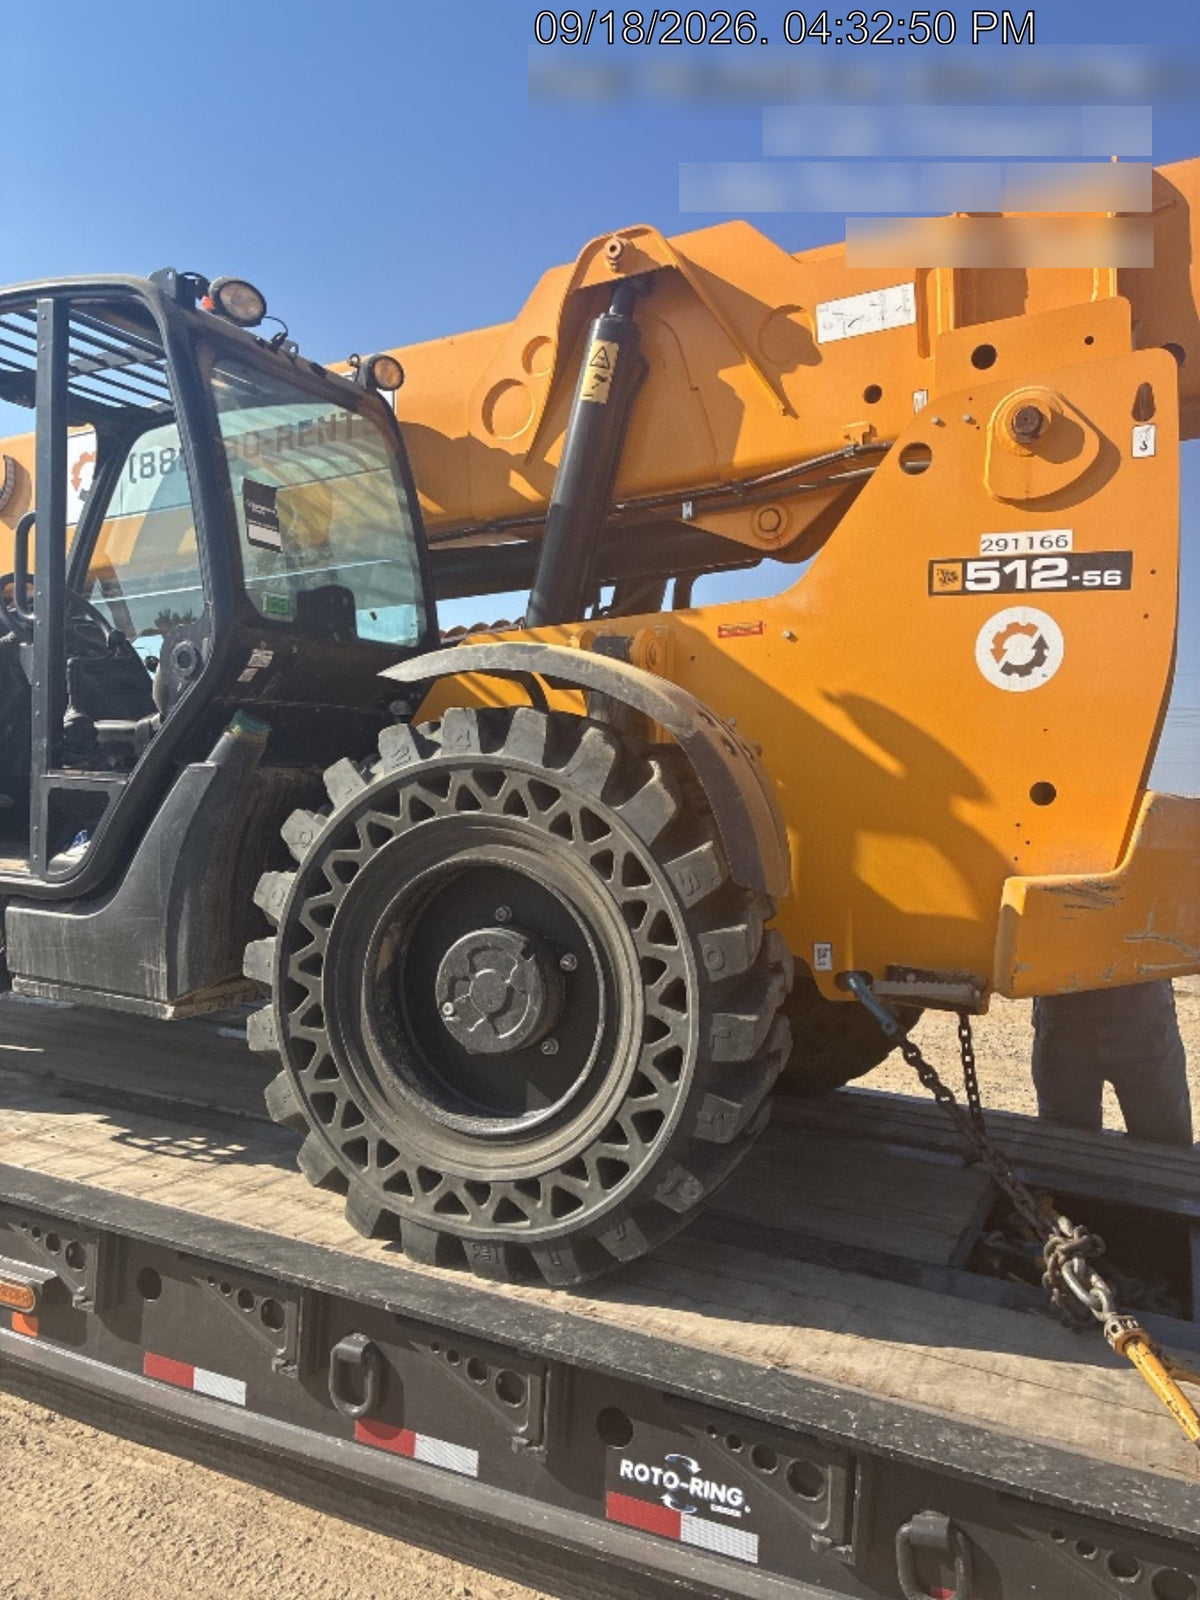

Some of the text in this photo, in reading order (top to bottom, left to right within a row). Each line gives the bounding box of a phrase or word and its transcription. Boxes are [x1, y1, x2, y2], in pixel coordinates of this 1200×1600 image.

[980, 534, 1069, 553] 291166
[964, 557, 1123, 591] 512-56
[619, 1458, 744, 1507] ROTO-RING
